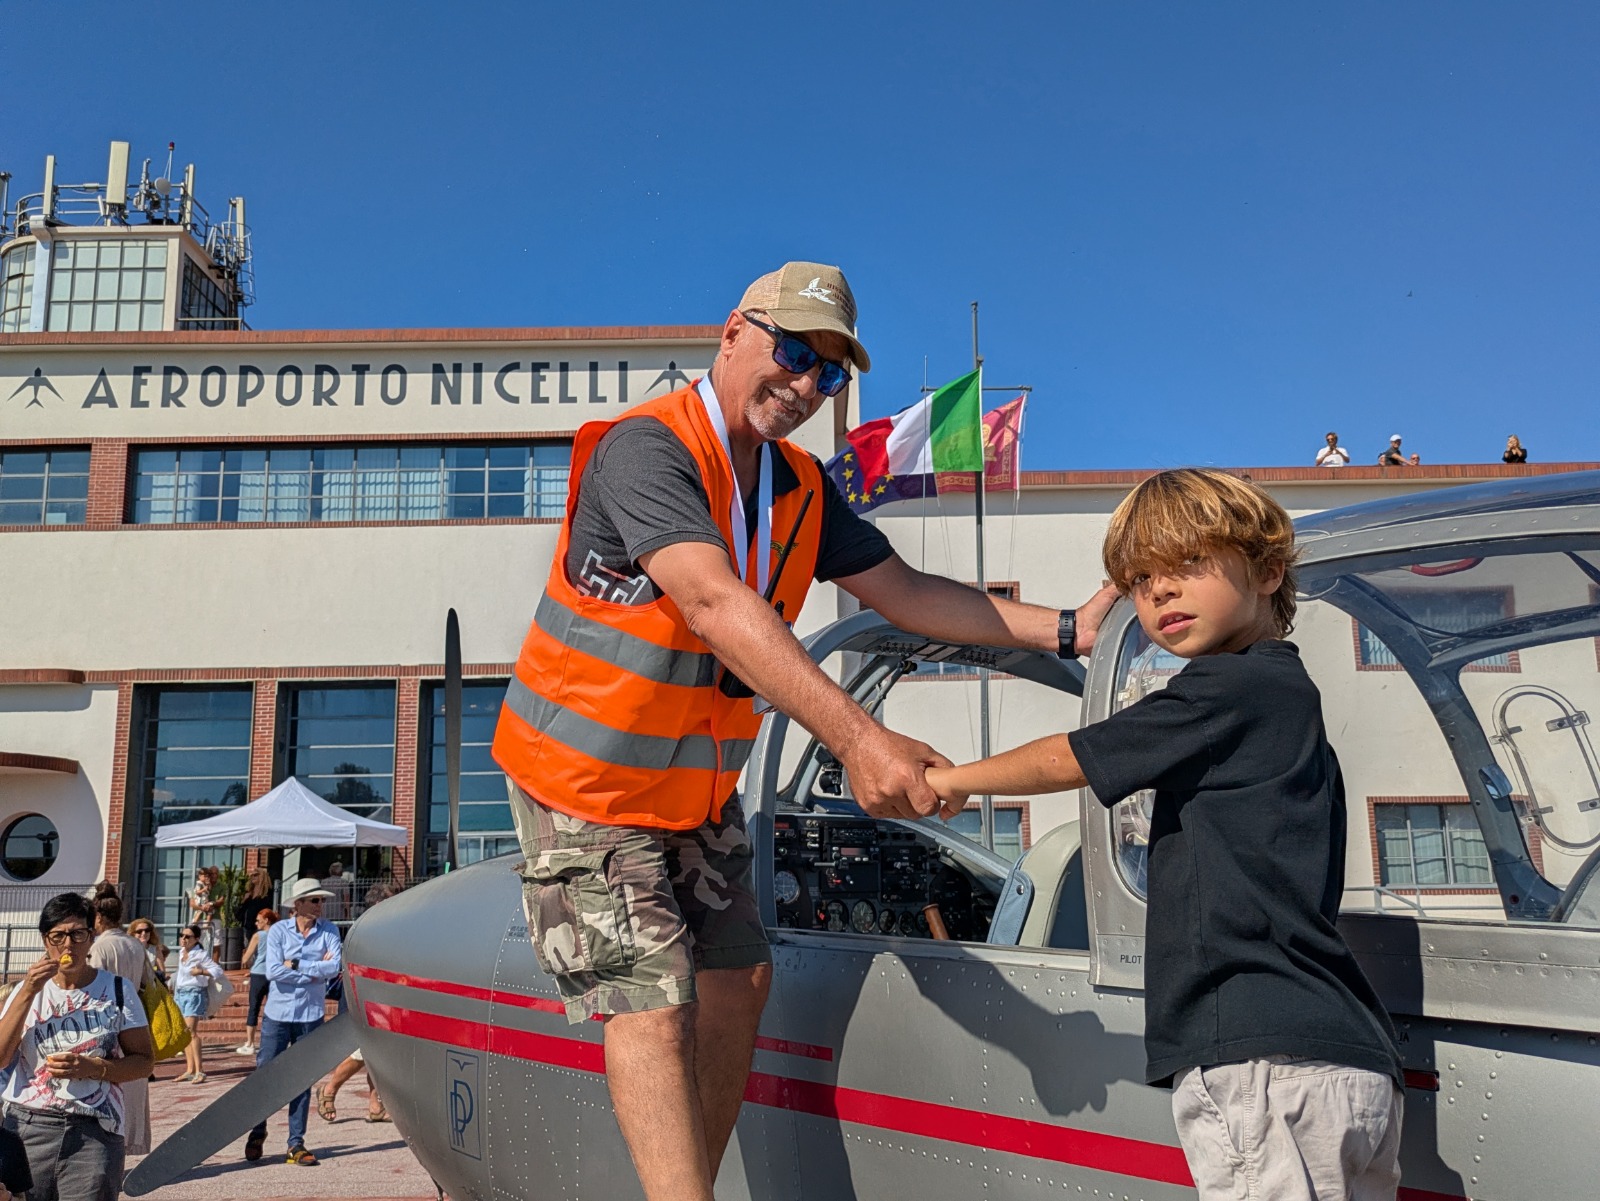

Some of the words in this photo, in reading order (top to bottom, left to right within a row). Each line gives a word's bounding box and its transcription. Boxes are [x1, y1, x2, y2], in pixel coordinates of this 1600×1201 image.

[81, 364, 408, 408] AEROPORTO
[430, 360, 629, 405] NICELLI
[1119, 954, 1143, 964] PILOT
